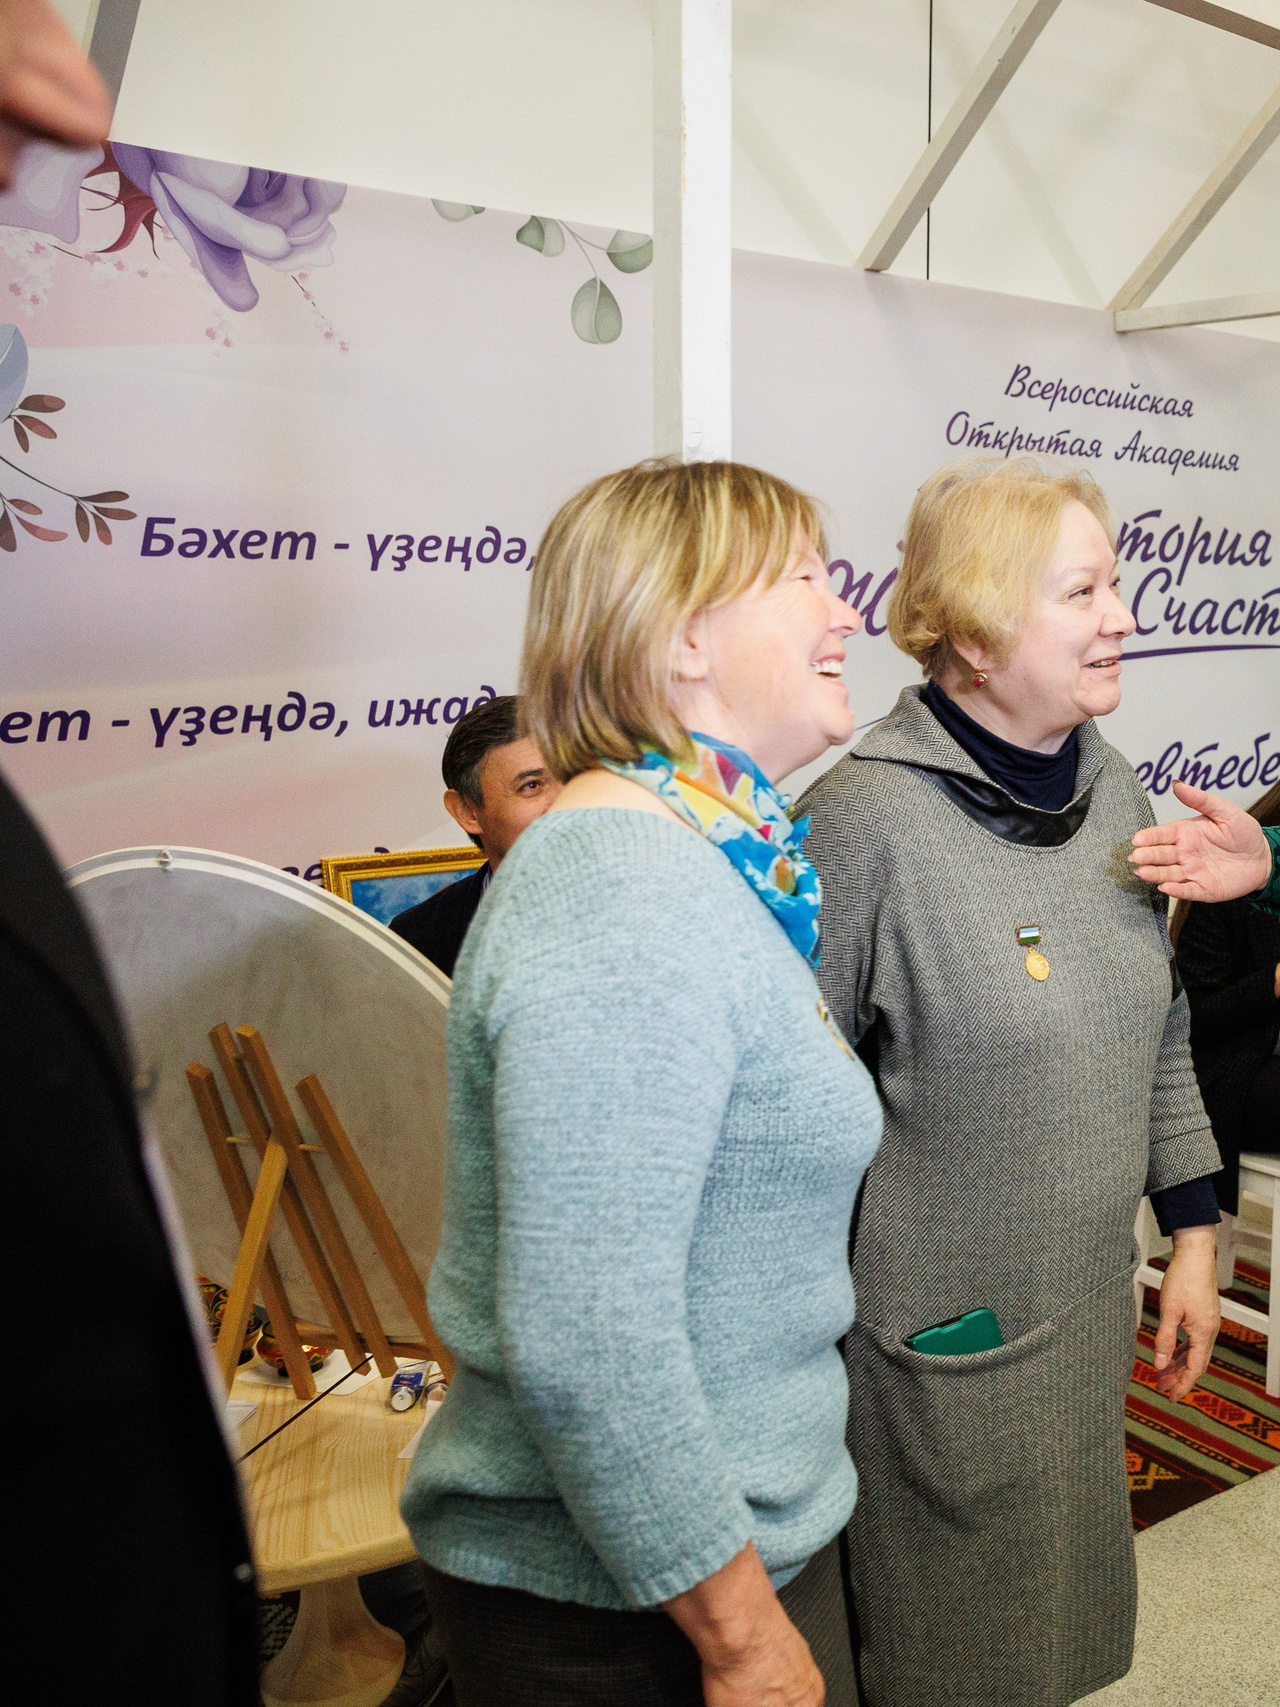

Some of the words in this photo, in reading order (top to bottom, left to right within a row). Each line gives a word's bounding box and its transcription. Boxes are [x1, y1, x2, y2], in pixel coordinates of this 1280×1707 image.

[1004, 363, 1194, 418] Всероссийская
[945, 411, 1102, 459] Открытая
[1114, 430, 1239, 475] Академия
[139, 516, 317, 561] Бәхет
[149, 691, 349, 748] үҙеңдә,
